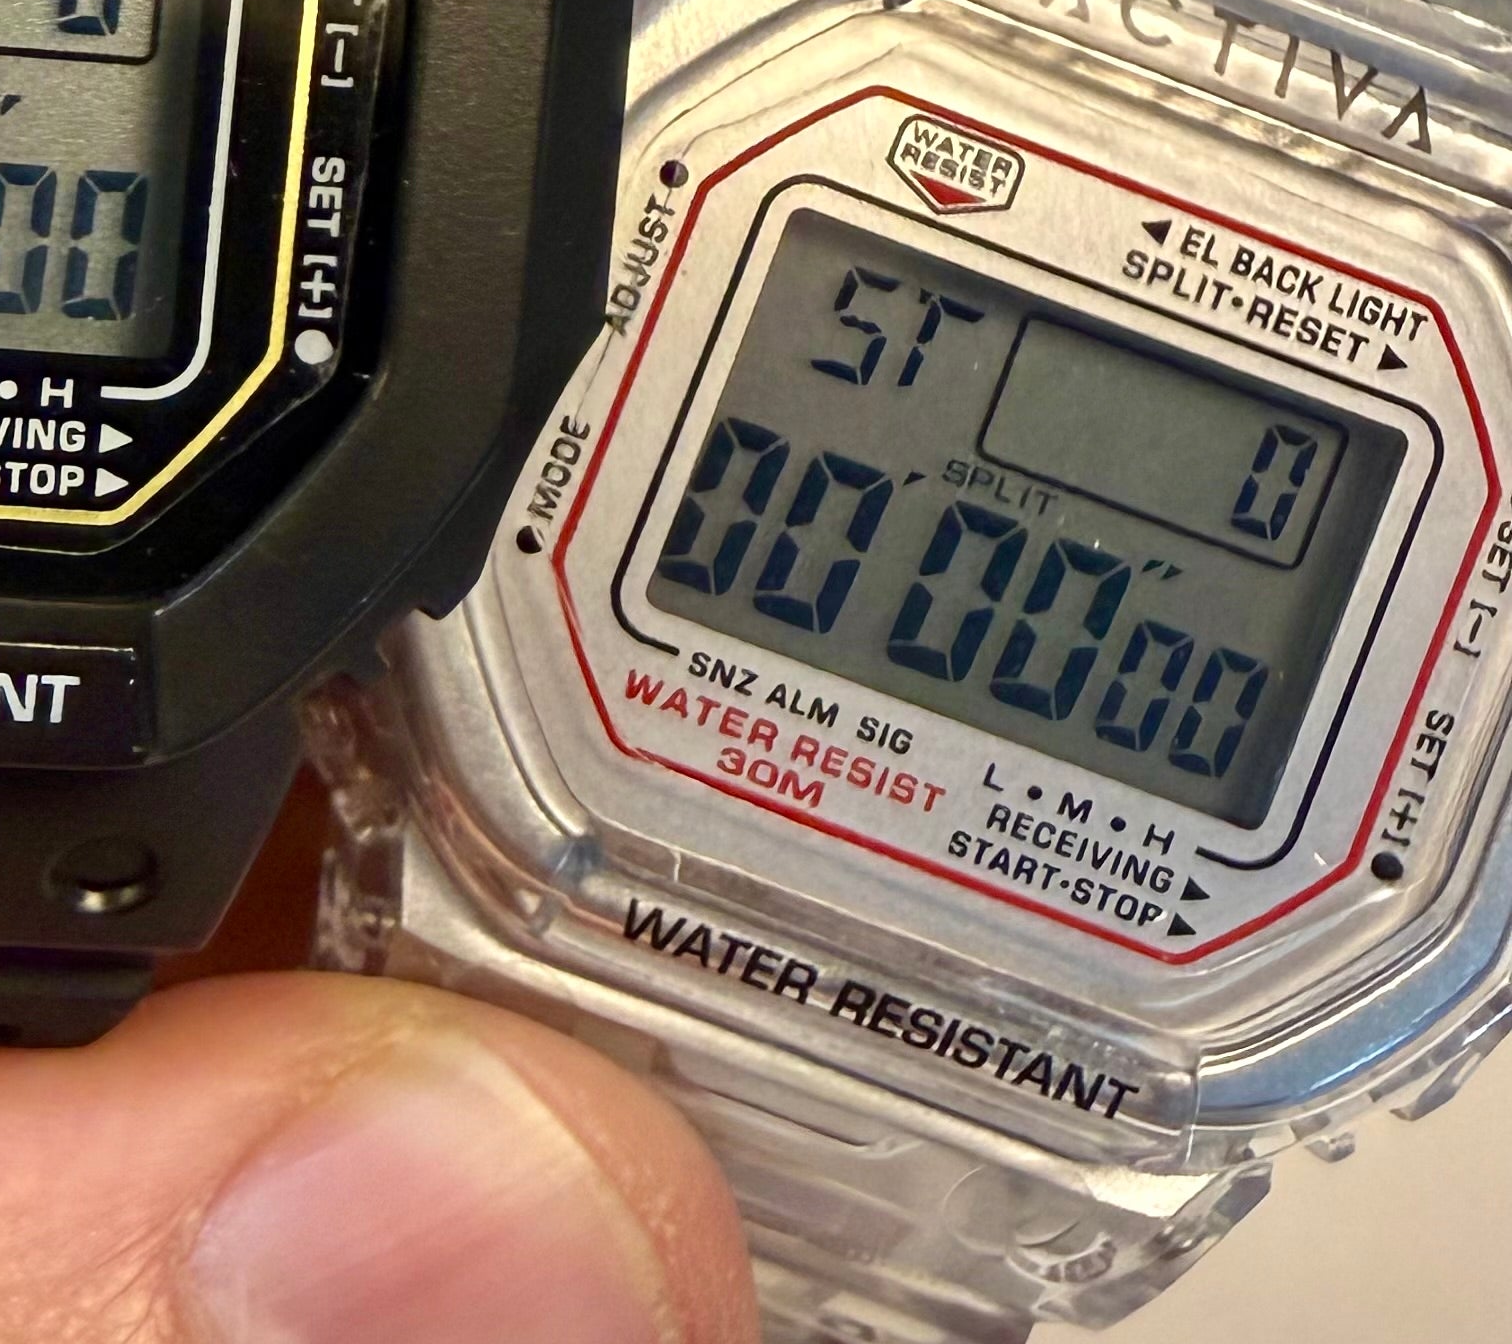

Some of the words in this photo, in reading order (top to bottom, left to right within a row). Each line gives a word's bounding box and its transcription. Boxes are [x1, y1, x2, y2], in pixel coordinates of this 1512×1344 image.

[306, 156, 345, 238] SET
[900, 142, 1009, 197] RESIST
[913, 124, 1014, 176] WATER
[604, 192, 678, 338] ADJUST
[1179, 227, 1220, 267] EL
[1233, 244, 1324, 307] BACK
[1330, 282, 1430, 343] LIGHT
[526, 414, 592, 523] MODE
[940, 459, 1061, 517] SPLIT
[624, 667, 780, 752] WATER
[790, 733, 947, 814] RESIST
[688, 651, 759, 698] SNZ
[766, 683, 840, 725] ALM
[855, 715, 914, 757] SIG
[1418, 709, 1457, 784] SET
[716, 747, 826, 807] 30M
[986, 802, 1175, 896] RECEIVING
[623, 897, 818, 1006] WATER
[829, 978, 1140, 1120] RESISTANT
